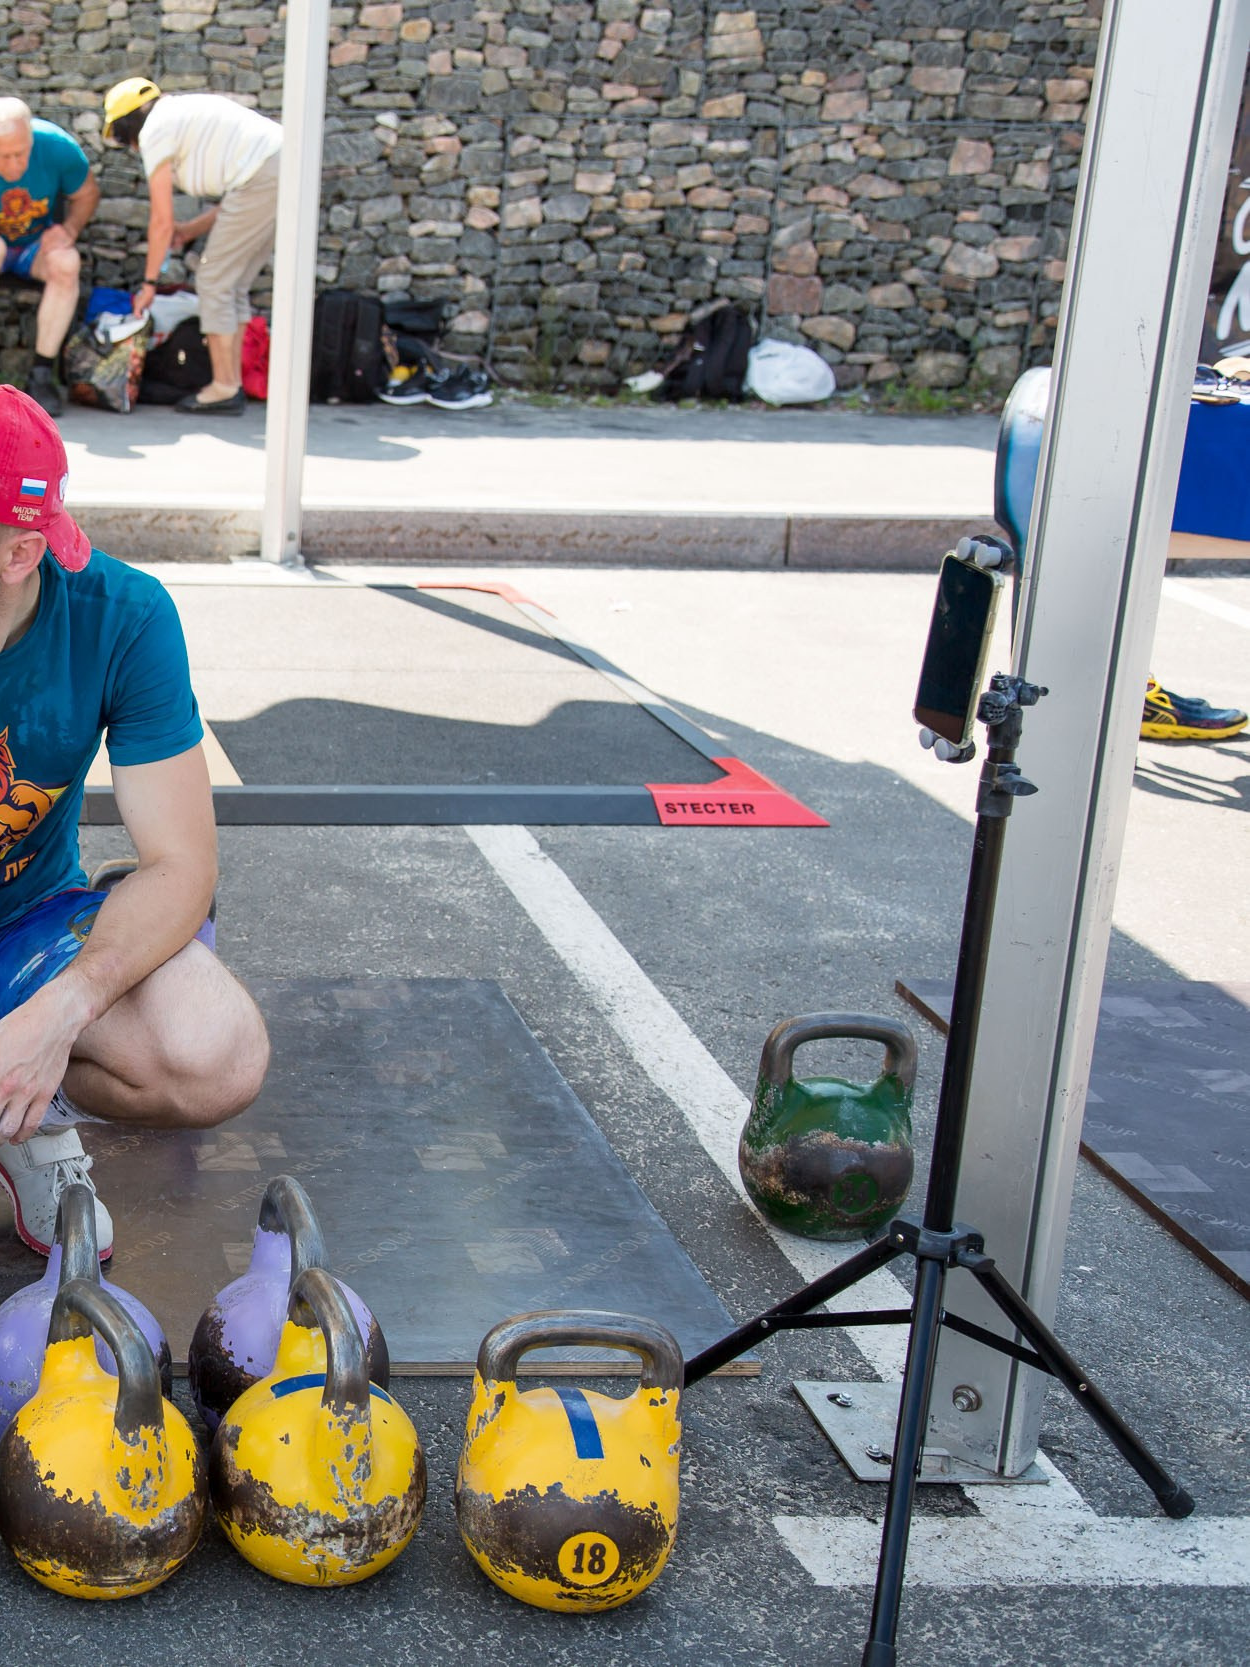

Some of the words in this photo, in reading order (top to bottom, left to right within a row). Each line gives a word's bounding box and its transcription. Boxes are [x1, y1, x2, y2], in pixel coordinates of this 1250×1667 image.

[12, 505, 42, 516] NATIONAL
[17, 513, 35, 522] TEAM
[664, 802, 756, 815] STECTER
[1088, 1120, 1138, 1137] OUP
[572, 1542, 607, 1575] 18
